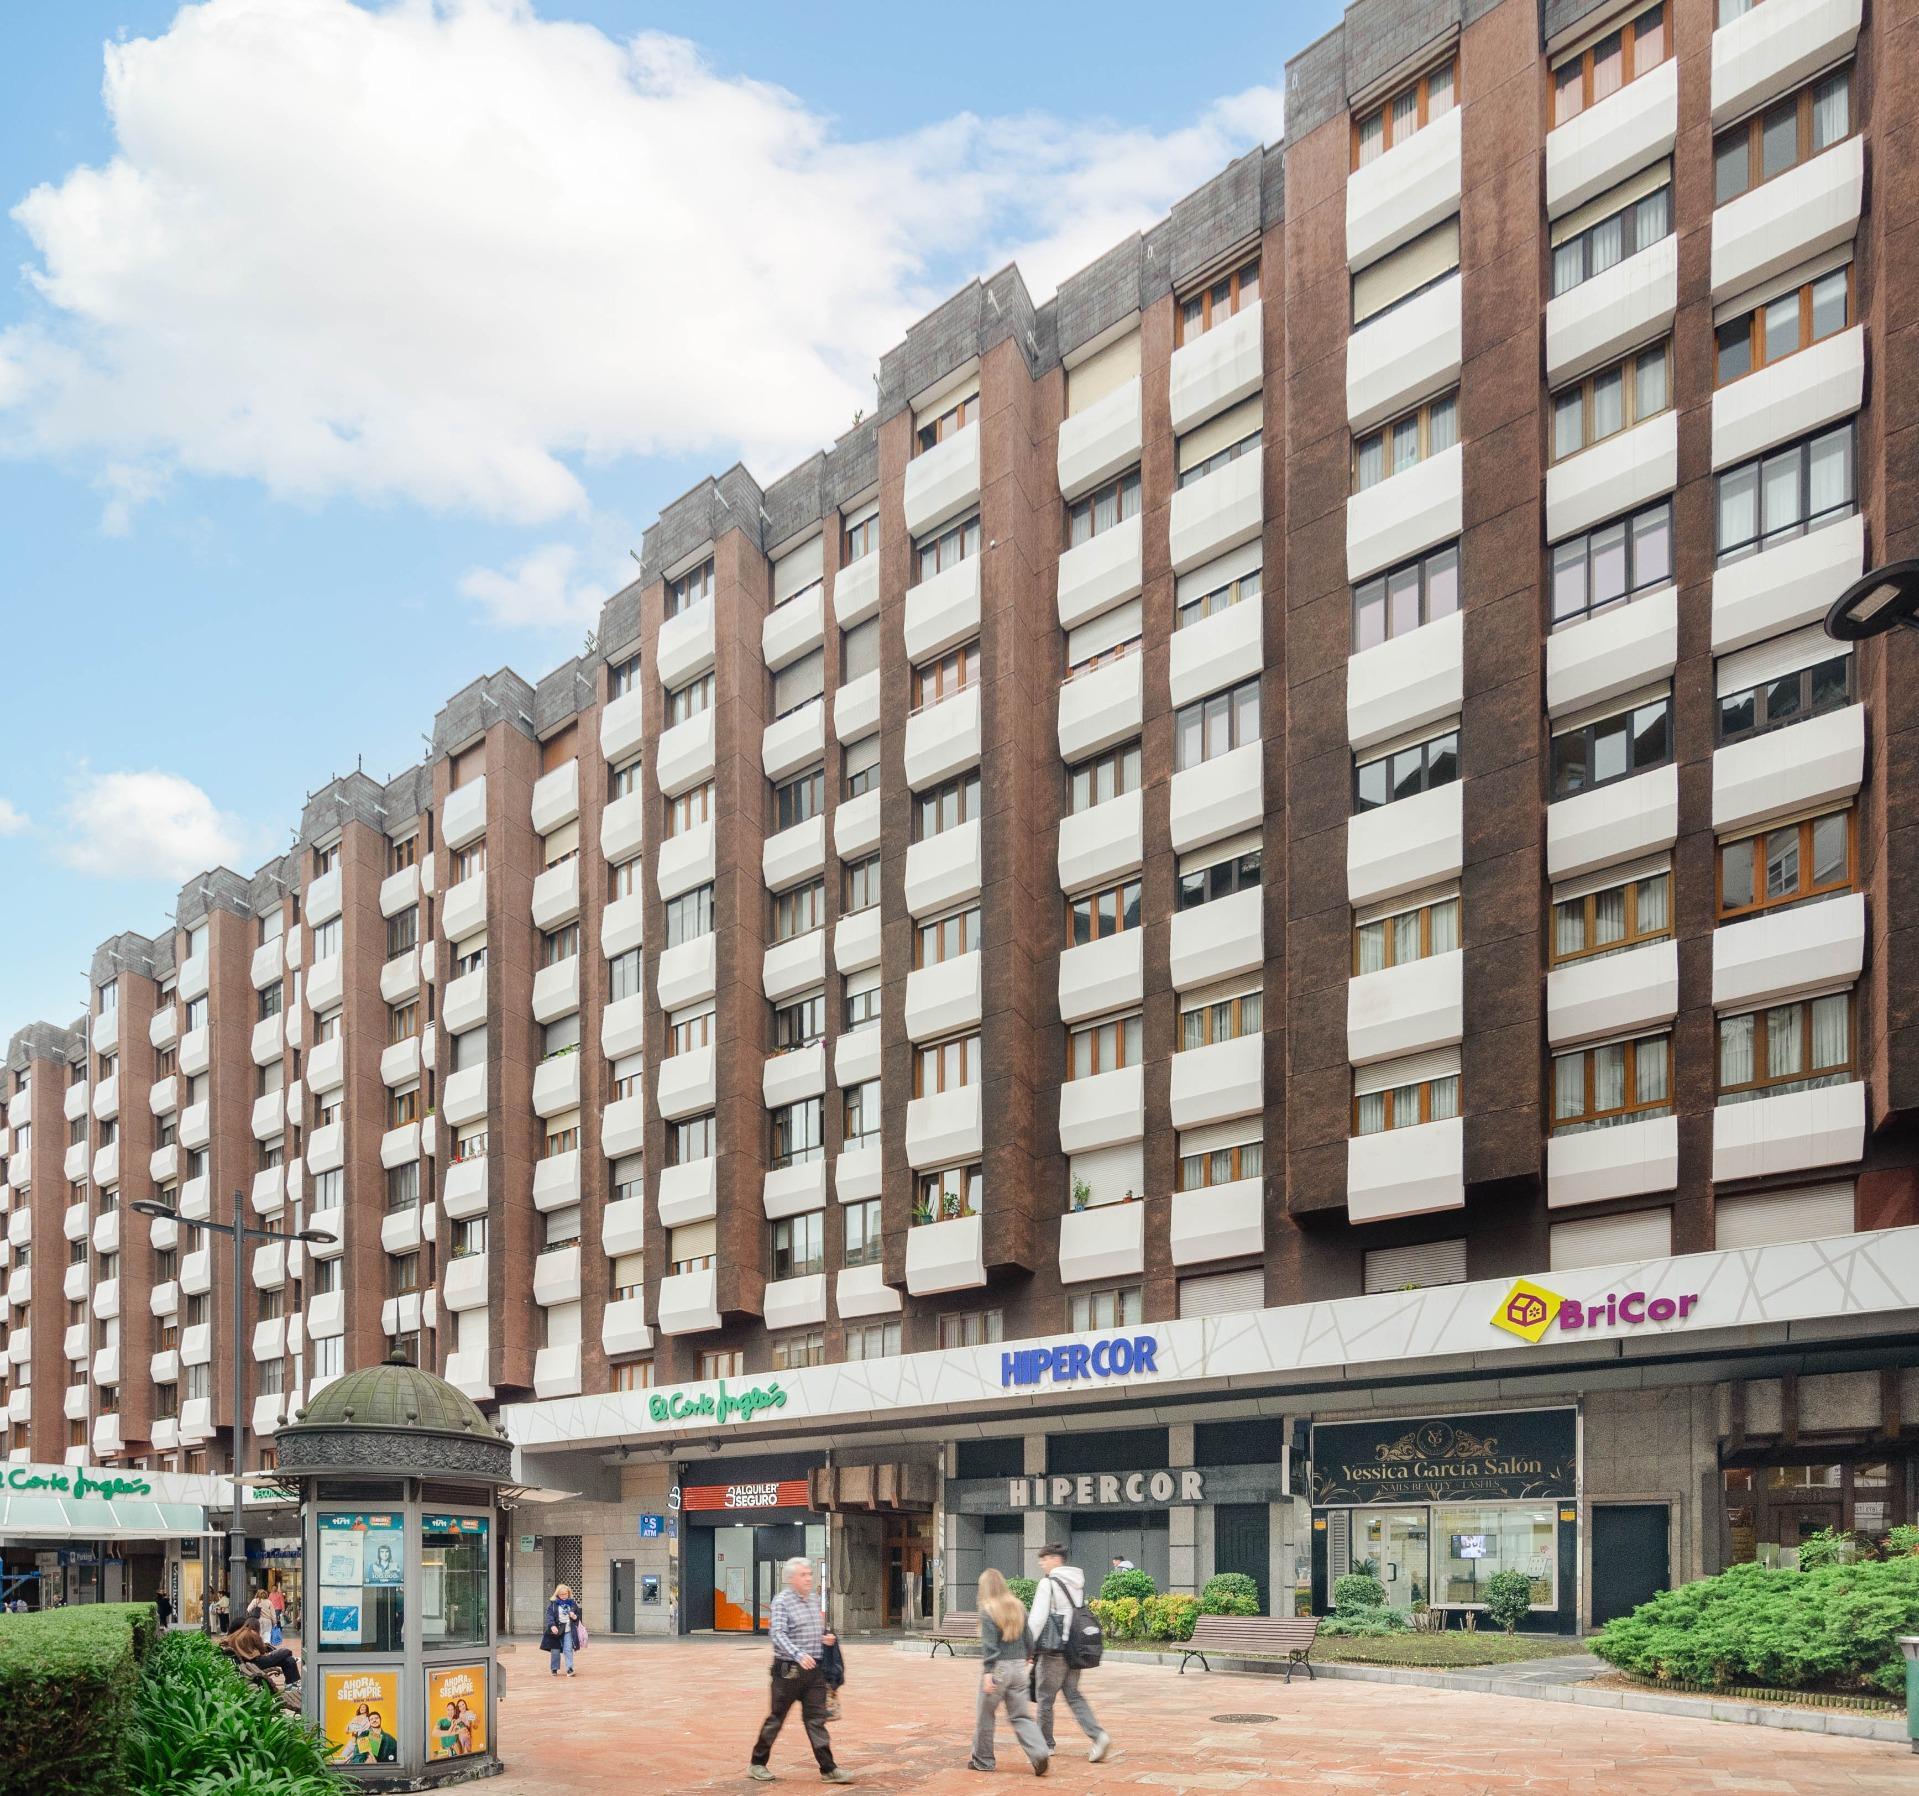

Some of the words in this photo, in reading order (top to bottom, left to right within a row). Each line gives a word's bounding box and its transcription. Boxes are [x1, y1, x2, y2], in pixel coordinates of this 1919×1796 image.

[560, 1291, 698, 1330] BriCor
[1001, 1335, 1158, 1387] HIPERCOR
[648, 1394, 669, 1421] El
[669, 1392, 715, 1419] Corte
[716, 1380, 787, 1424] Inglés
[1342, 1462, 1409, 1481] Yessica
[1484, 1456, 1542, 1474] Salón
[8, 1469, 69, 1490] Corte
[73, 1466, 151, 1500] Inglés
[736, 1483, 777, 1495] ALQUILER
[1009, 1471, 1207, 1507] HIPERCOR
[1381, 1482, 1409, 1492] NAILS
[1462, 1479, 1500, 1489] LASHES
[735, 1494, 778, 1507] SEGURO
[643, 1529, 657, 1537] ATM
[343, 1677, 375, 1690] AHORA
[443, 1674, 468, 1687] AHORA
[337, 1686, 382, 1700] SIEMPRE
[439, 1682, 474, 1698] SIEMPRE
